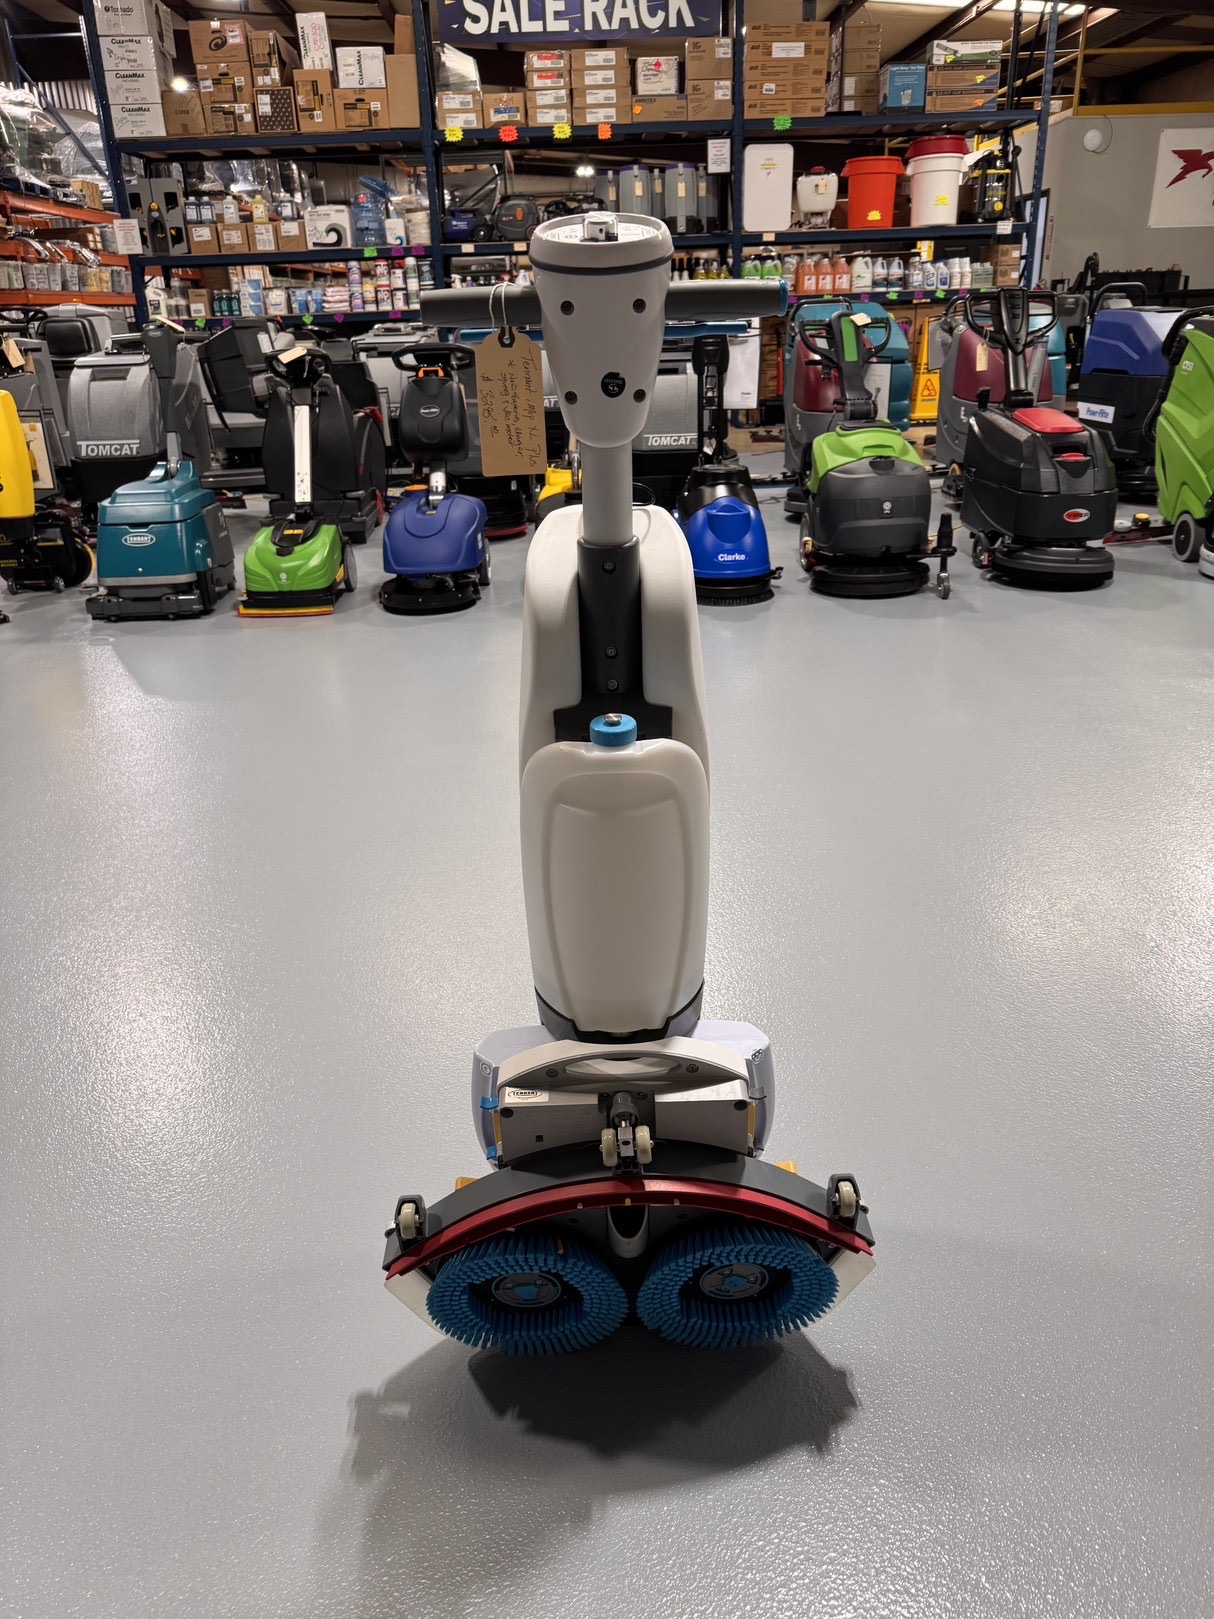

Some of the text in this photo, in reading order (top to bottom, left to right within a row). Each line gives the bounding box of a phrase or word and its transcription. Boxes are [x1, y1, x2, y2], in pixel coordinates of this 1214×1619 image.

[464, 0, 696, 35] SALE RACK
[643, 433, 698, 447] TOMCAT
[76, 440, 140, 457] TOMCAT
[717, 553, 746, 562] Clarke
